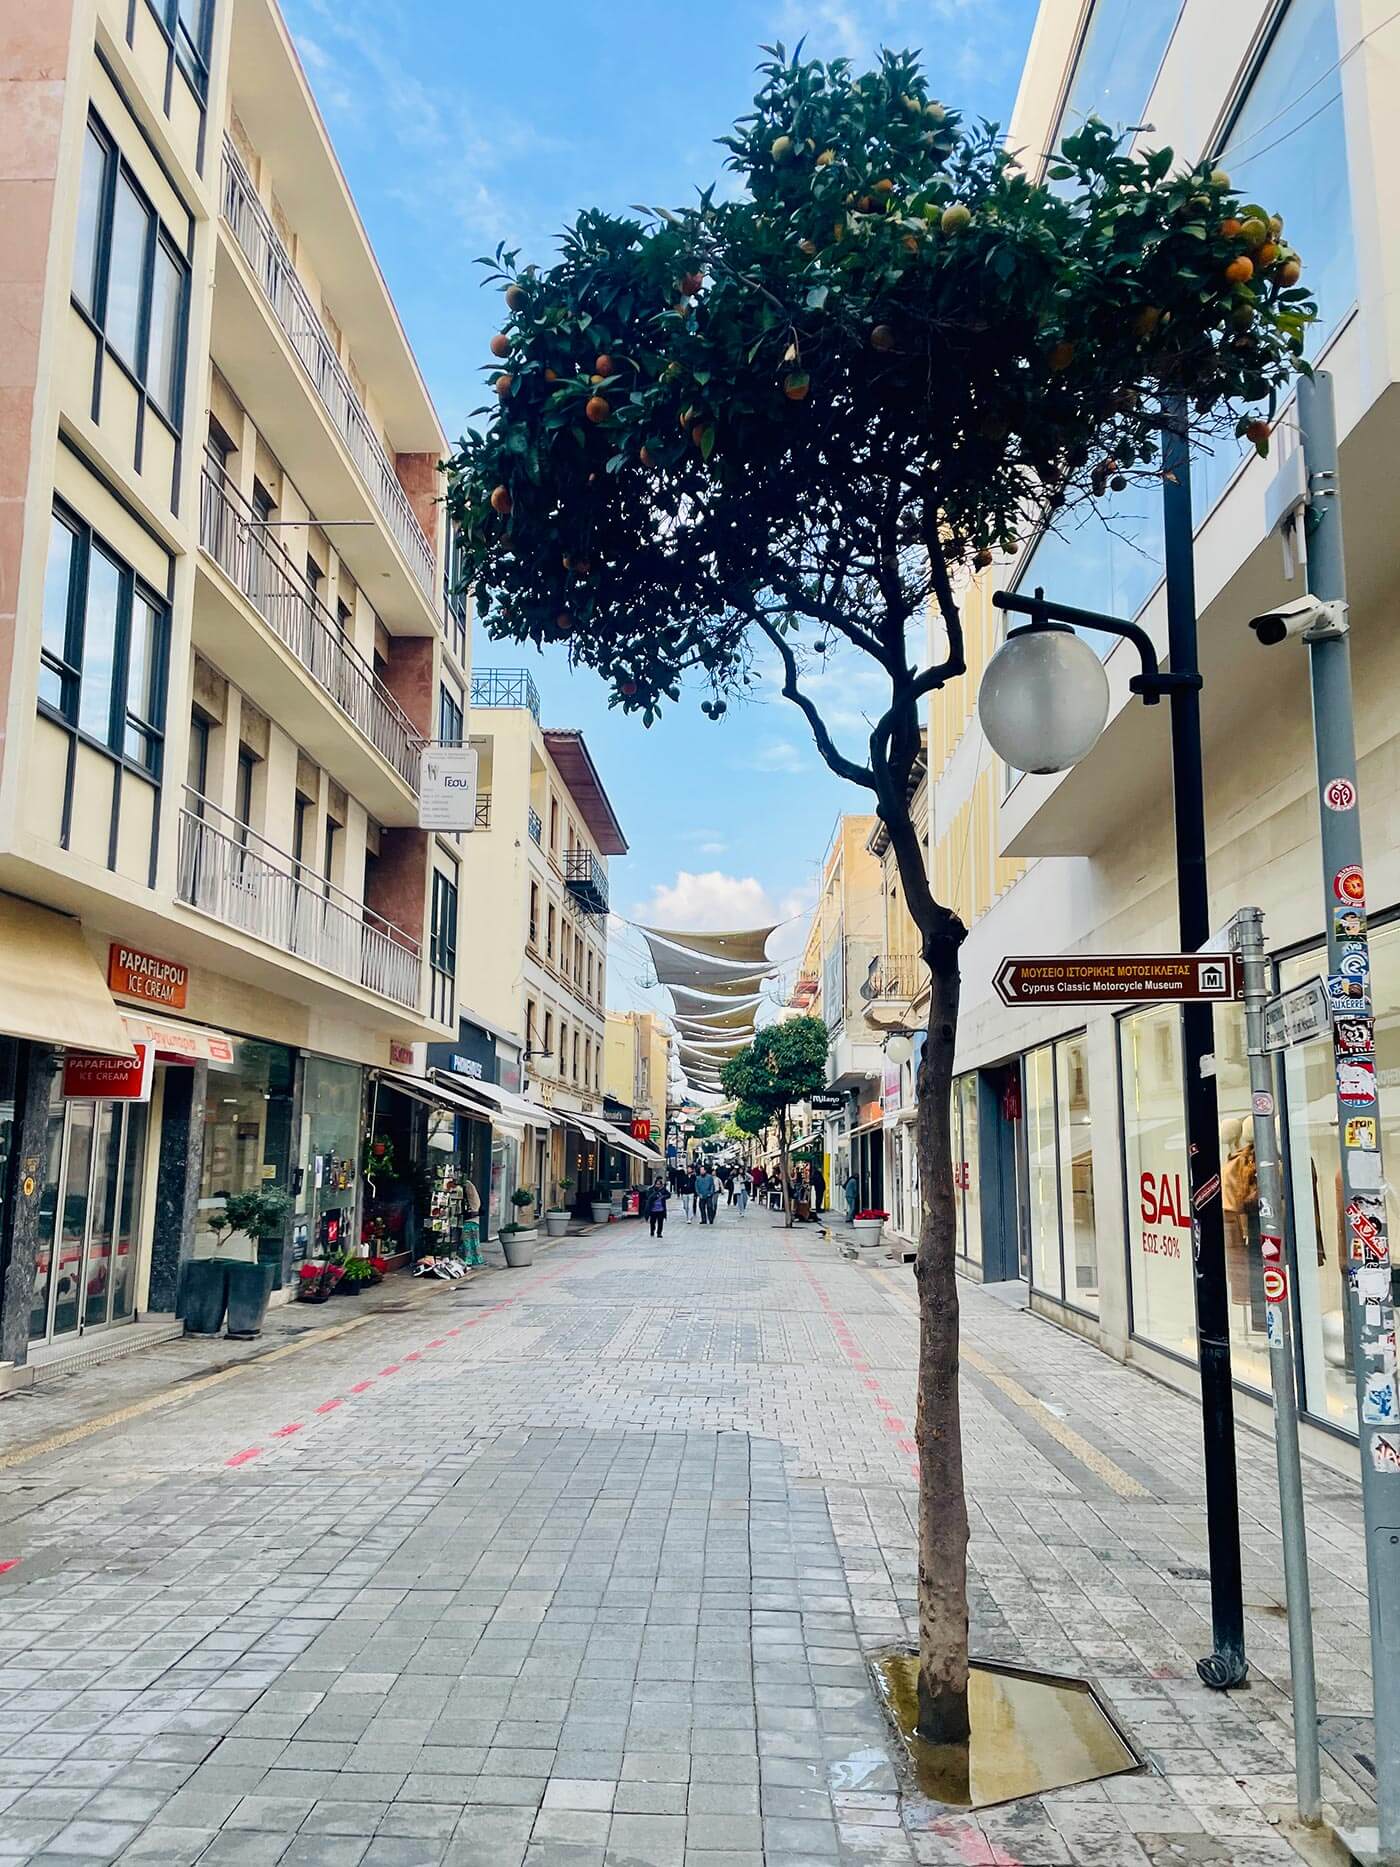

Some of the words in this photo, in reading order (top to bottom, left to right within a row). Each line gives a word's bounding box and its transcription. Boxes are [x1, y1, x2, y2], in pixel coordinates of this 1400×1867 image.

[1021, 967, 1064, 978] ΜΟΥΣΕΙΟ
[1066, 966, 1115, 978] ΙΣΤΟΡΙΚΗΣ
[1117, 965, 1191, 976] ΜΟΤΟΣΙΚΛΕΤΑΣ
[1207, 975, 1217, 985] M
[128, 974, 142, 993] ICE
[144, 979, 176, 1001] CREAM
[1021, 983, 1055, 995] Cyprus
[1057, 982, 1091, 992] Classic
[1093, 980, 1143, 992] Motorcycle
[1144, 980, 1183, 990] Museum
[1332, 1000, 1364, 1009] AUXERRE
[80, 1072, 93, 1081] ICE
[96, 1072, 129, 1081] CREAM
[1140, 1171, 1193, 1228] SAL
[1142, 1231, 1159, 1254] ΕΩΣ
[1160, 1235, 1181, 1259] -50%
